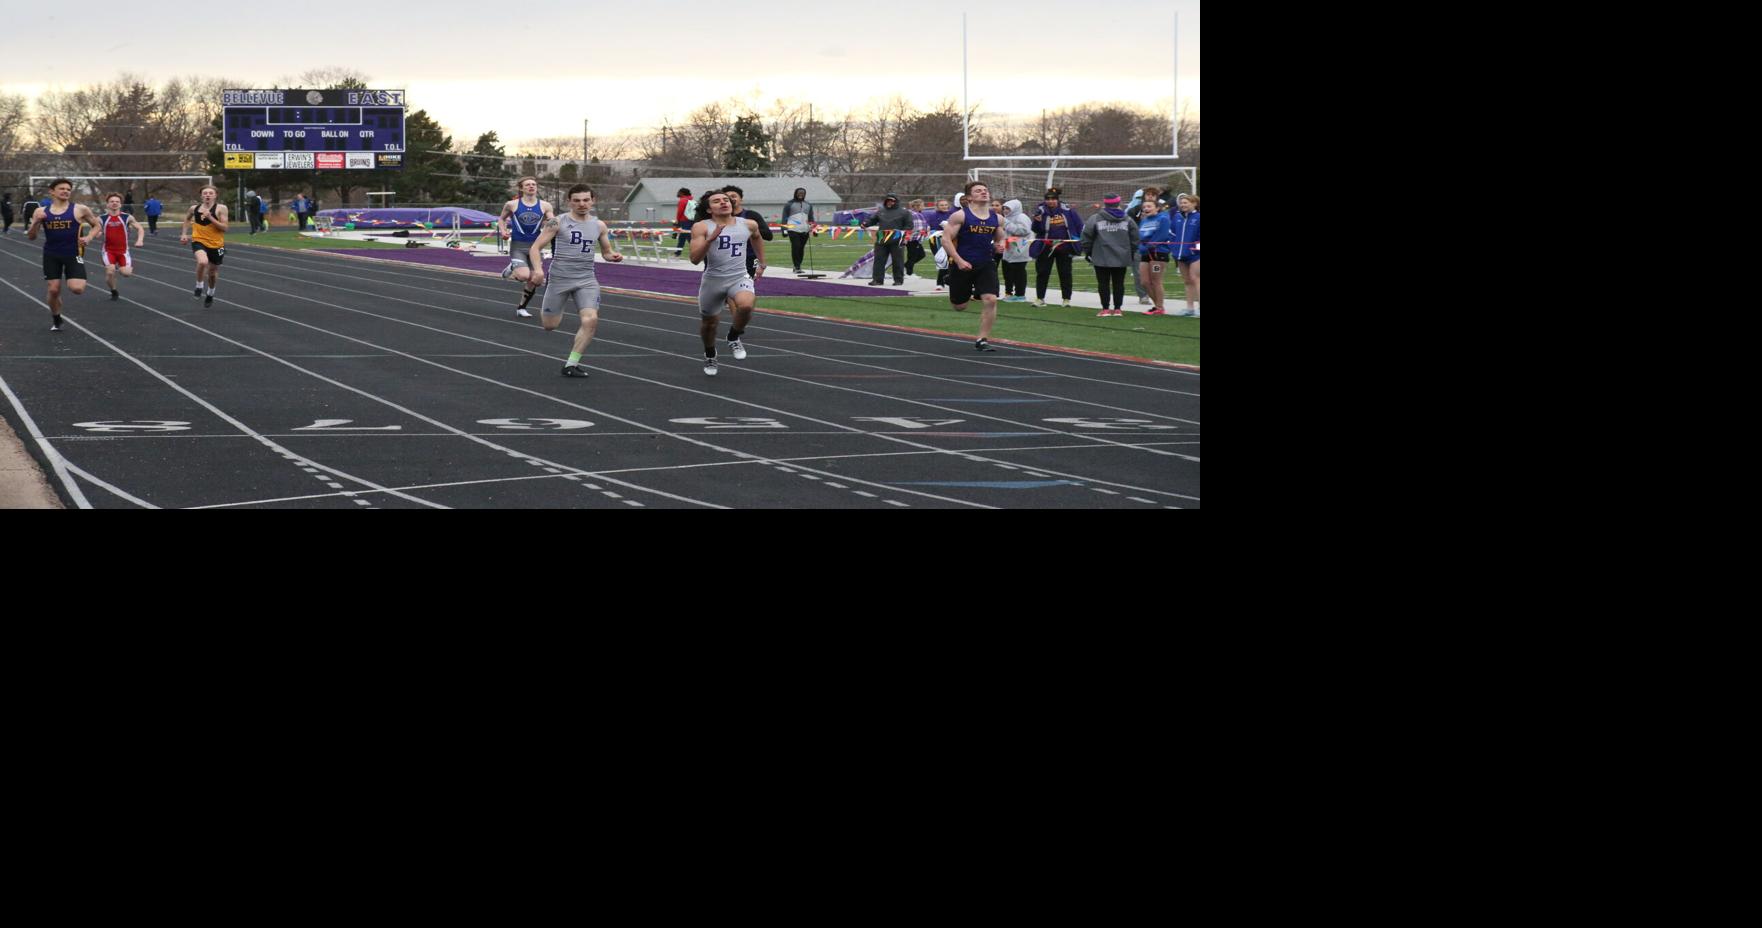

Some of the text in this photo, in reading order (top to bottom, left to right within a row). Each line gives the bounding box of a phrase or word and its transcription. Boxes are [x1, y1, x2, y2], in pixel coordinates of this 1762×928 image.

[223, 91, 284, 105] BELLEVUE
[348, 92, 404, 105] EAST
[251, 130, 274, 138] DOWN
[283, 130, 306, 138] TO GO
[321, 130, 349, 138] BALL ON
[359, 130, 374, 138] QTR
[225, 143, 244, 151] T.O.L.
[384, 143, 403, 151] T.O.L.
[288, 153, 312, 161] ERWIN'S
[286, 161, 314, 169] JEWELERS
[45, 220, 72, 230] WEST
[968, 225, 996, 235] WEST
[73, 420, 192, 432] 8
[291, 419, 402, 430] 7
[476, 418, 595, 430] 6
[669, 417, 790, 428] 5
[850, 417, 967, 429] 4
[1042, 417, 1179, 429] 3
